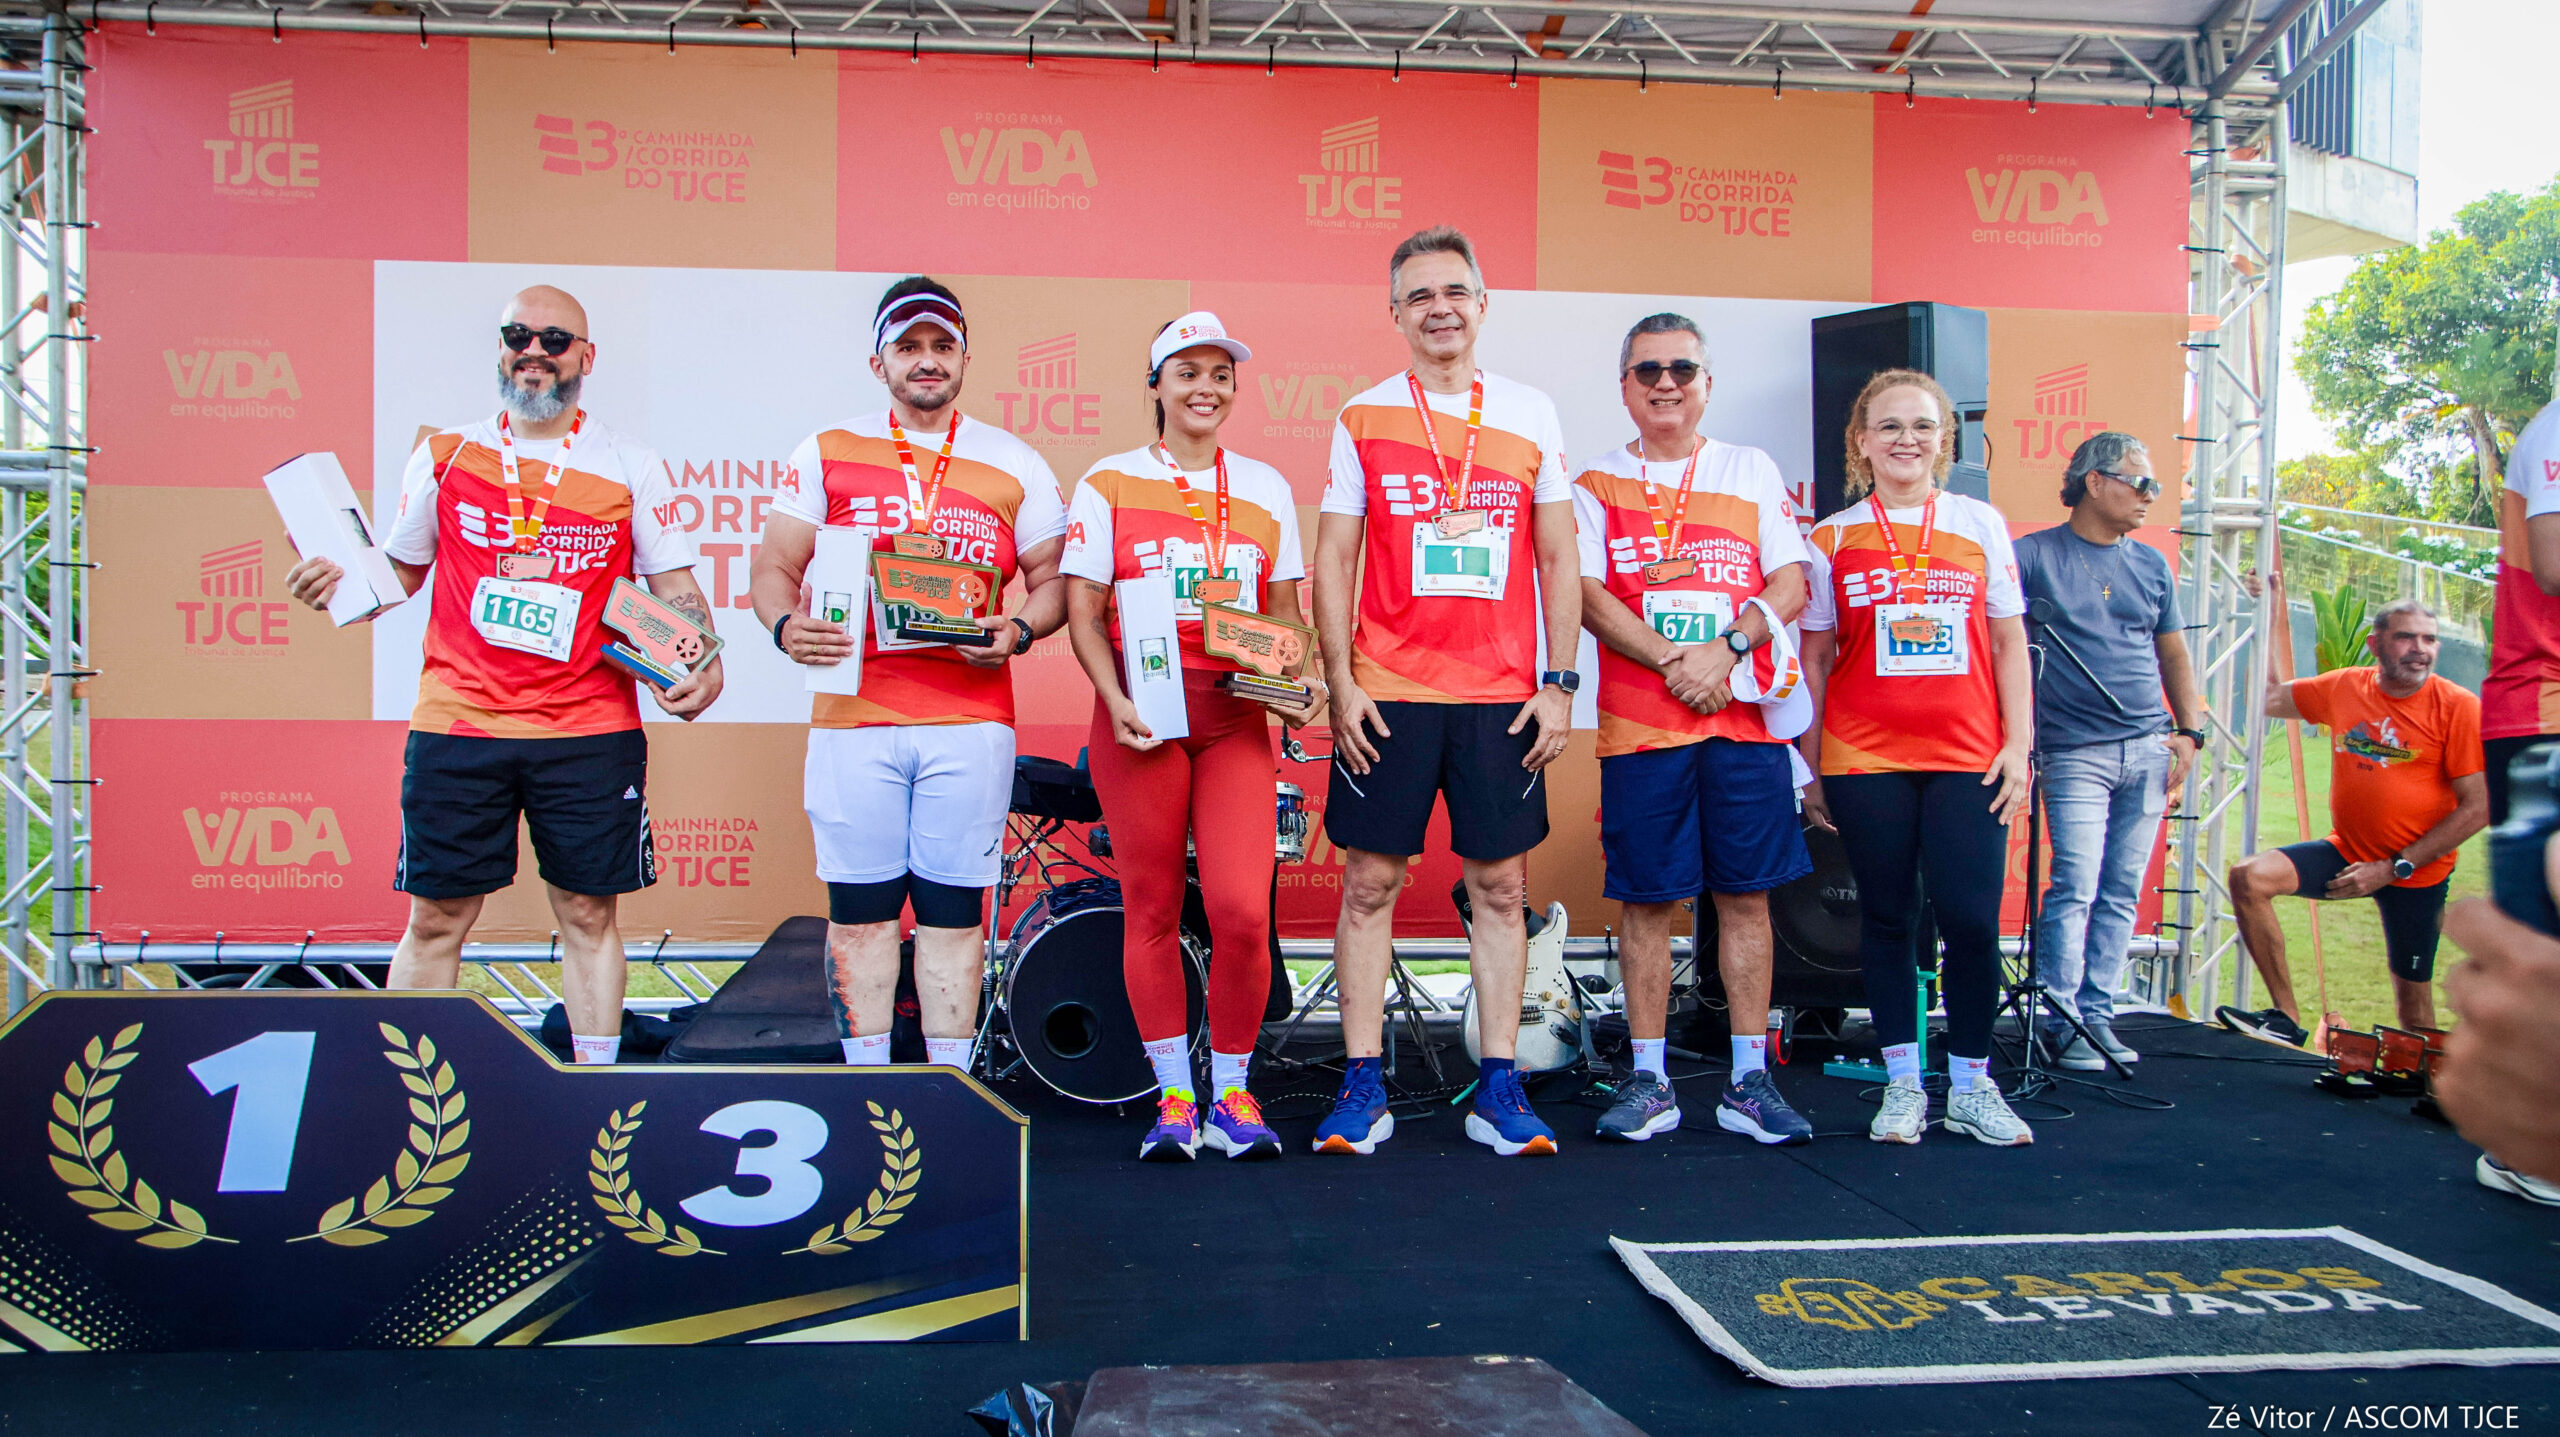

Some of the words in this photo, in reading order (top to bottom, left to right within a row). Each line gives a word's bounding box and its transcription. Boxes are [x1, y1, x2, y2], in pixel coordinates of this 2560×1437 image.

[976, 112, 1064, 125] PROGRAMA
[633, 129, 755, 148] CAMINHADA
[204, 140, 319, 187] TJCE
[940, 126, 1098, 188] VIDA
[1997, 154, 2077, 167] PROGRAMA
[624, 167, 662, 189] DO
[667, 170, 746, 203] TJCE
[1687, 166, 1799, 185] CAMINHADA
[947, 191, 979, 208] em
[984, 189, 1091, 215] equilíbrio
[1298, 174, 1402, 219] TJCE
[1965, 167, 2109, 226] VIDA
[1306, 218, 1347, 229] Tribunal
[1349, 220, 1363, 229] de
[1680, 202, 1715, 224] DO
[1719, 205, 1790, 237] TJCE
[1972, 229, 2000, 243] em
[2005, 226, 2102, 250] equilíbrio
[163, 349, 302, 401] VIDA
[170, 404, 197, 416] em
[994, 392, 1101, 435] TJCE
[1264, 424, 1289, 437] em
[490, 512, 516, 548] 3
[539, 523, 618, 536] AMINHADA
[881, 496, 910, 535] 3
[947, 536, 996, 566] TJCE
[1451, 547, 1463, 573] 1
[1639, 536, 1664, 567] 3
[1699, 563, 1750, 587] TJCE
[176, 602, 289, 645] TJCE
[488, 596, 556, 634] 1165
[1662, 614, 1705, 640] 671
[220, 792, 314, 802] PROGRAMA
[183, 807, 352, 866] VIDA
[652, 817, 759, 832] AMINHADA
[191, 873, 225, 888] em
[230, 868, 343, 894] equilíbrio
[672, 856, 750, 887] TJCE
[1277, 873, 1306, 888] em
[187, 1031, 316, 1192] 1
[679, 1100, 829, 1227] 3
[1918, 1267, 2383, 1300] CARLOS
[1961, 1286, 2424, 1323] LEVADA
